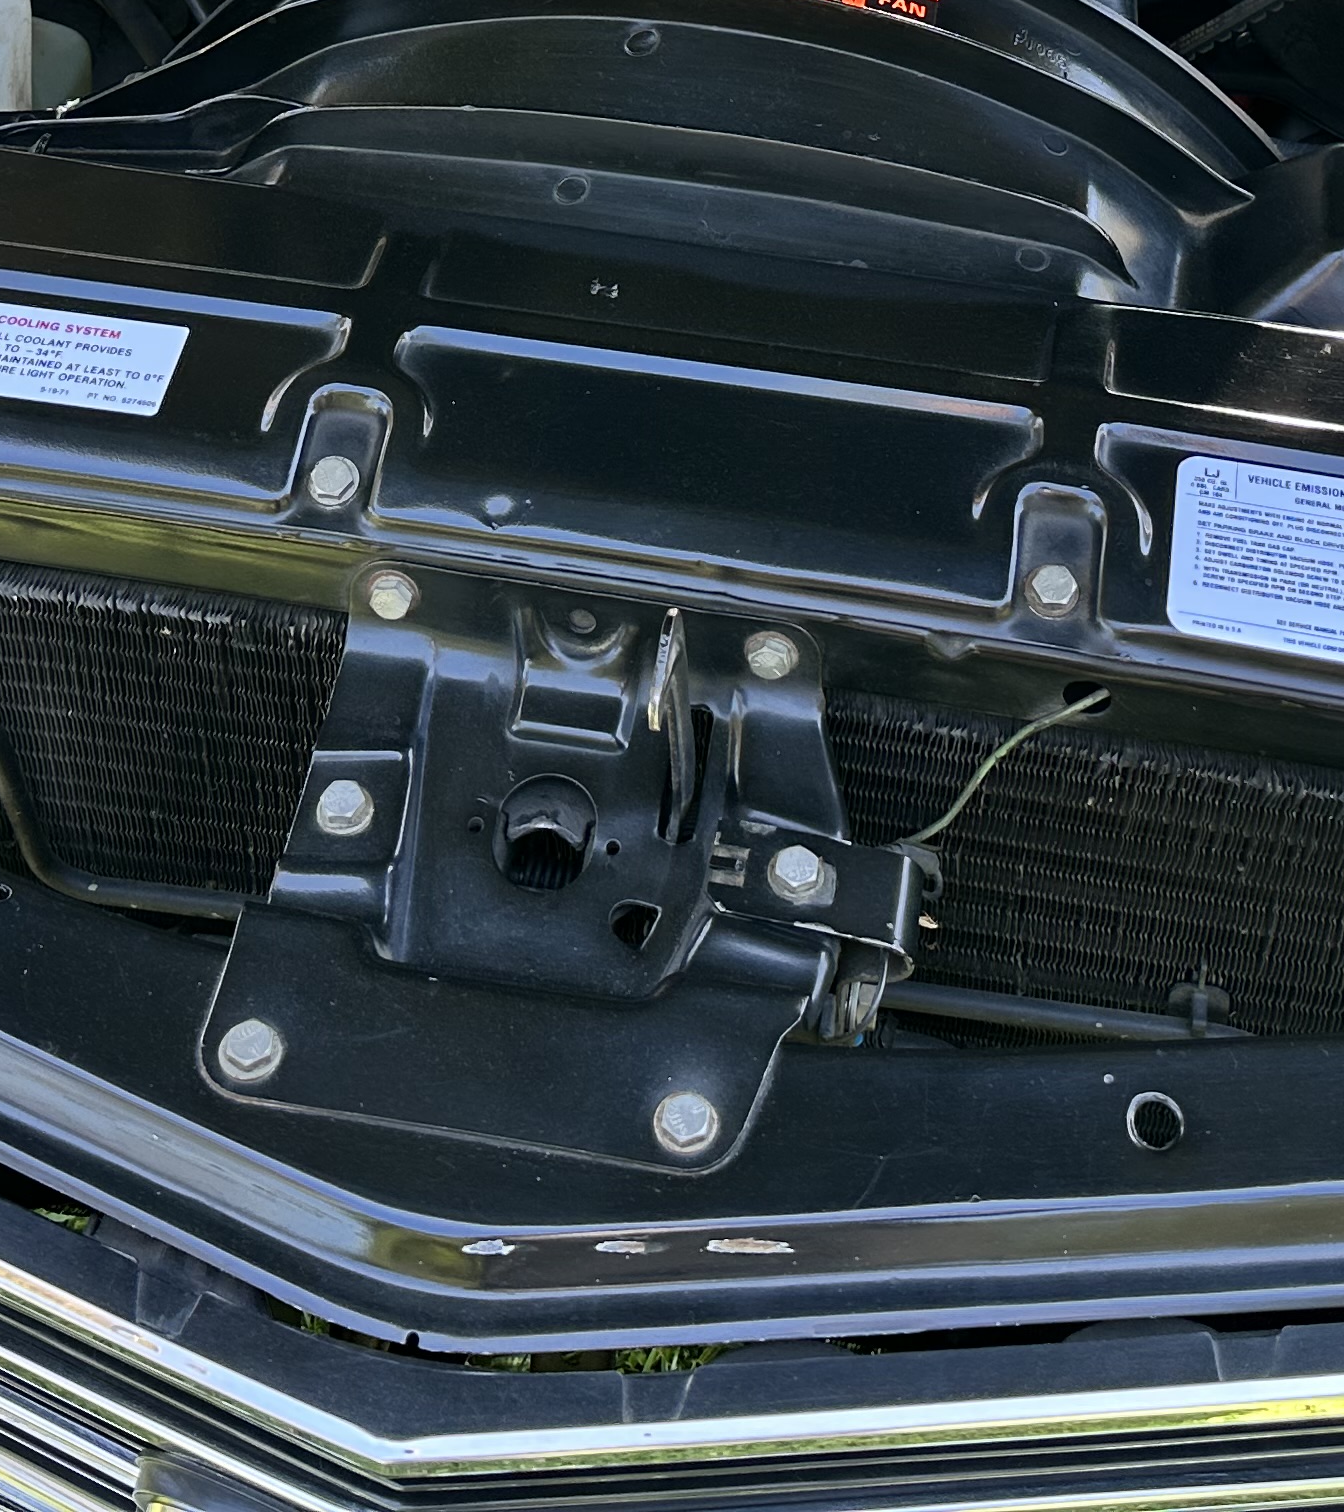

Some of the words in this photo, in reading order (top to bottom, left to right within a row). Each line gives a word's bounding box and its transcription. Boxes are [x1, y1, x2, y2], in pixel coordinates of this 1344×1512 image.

[64, 324, 122, 339] SYSTEM
[4, 343, 21, 352] TO
[14, 334, 71, 348] COOLANT
[74, 342, 133, 356] PROVIDES
[19, 367, 54, 379] LIGHT
[57, 373, 127, 389] OPERATION.
[65, 363, 81, 371] AT
[84, 365, 121, 377] LEAST
[124, 370, 140, 379] TO
[1248, 475, 1291, 489] VEHICLE
[1295, 497, 1330, 509] GENERAL
